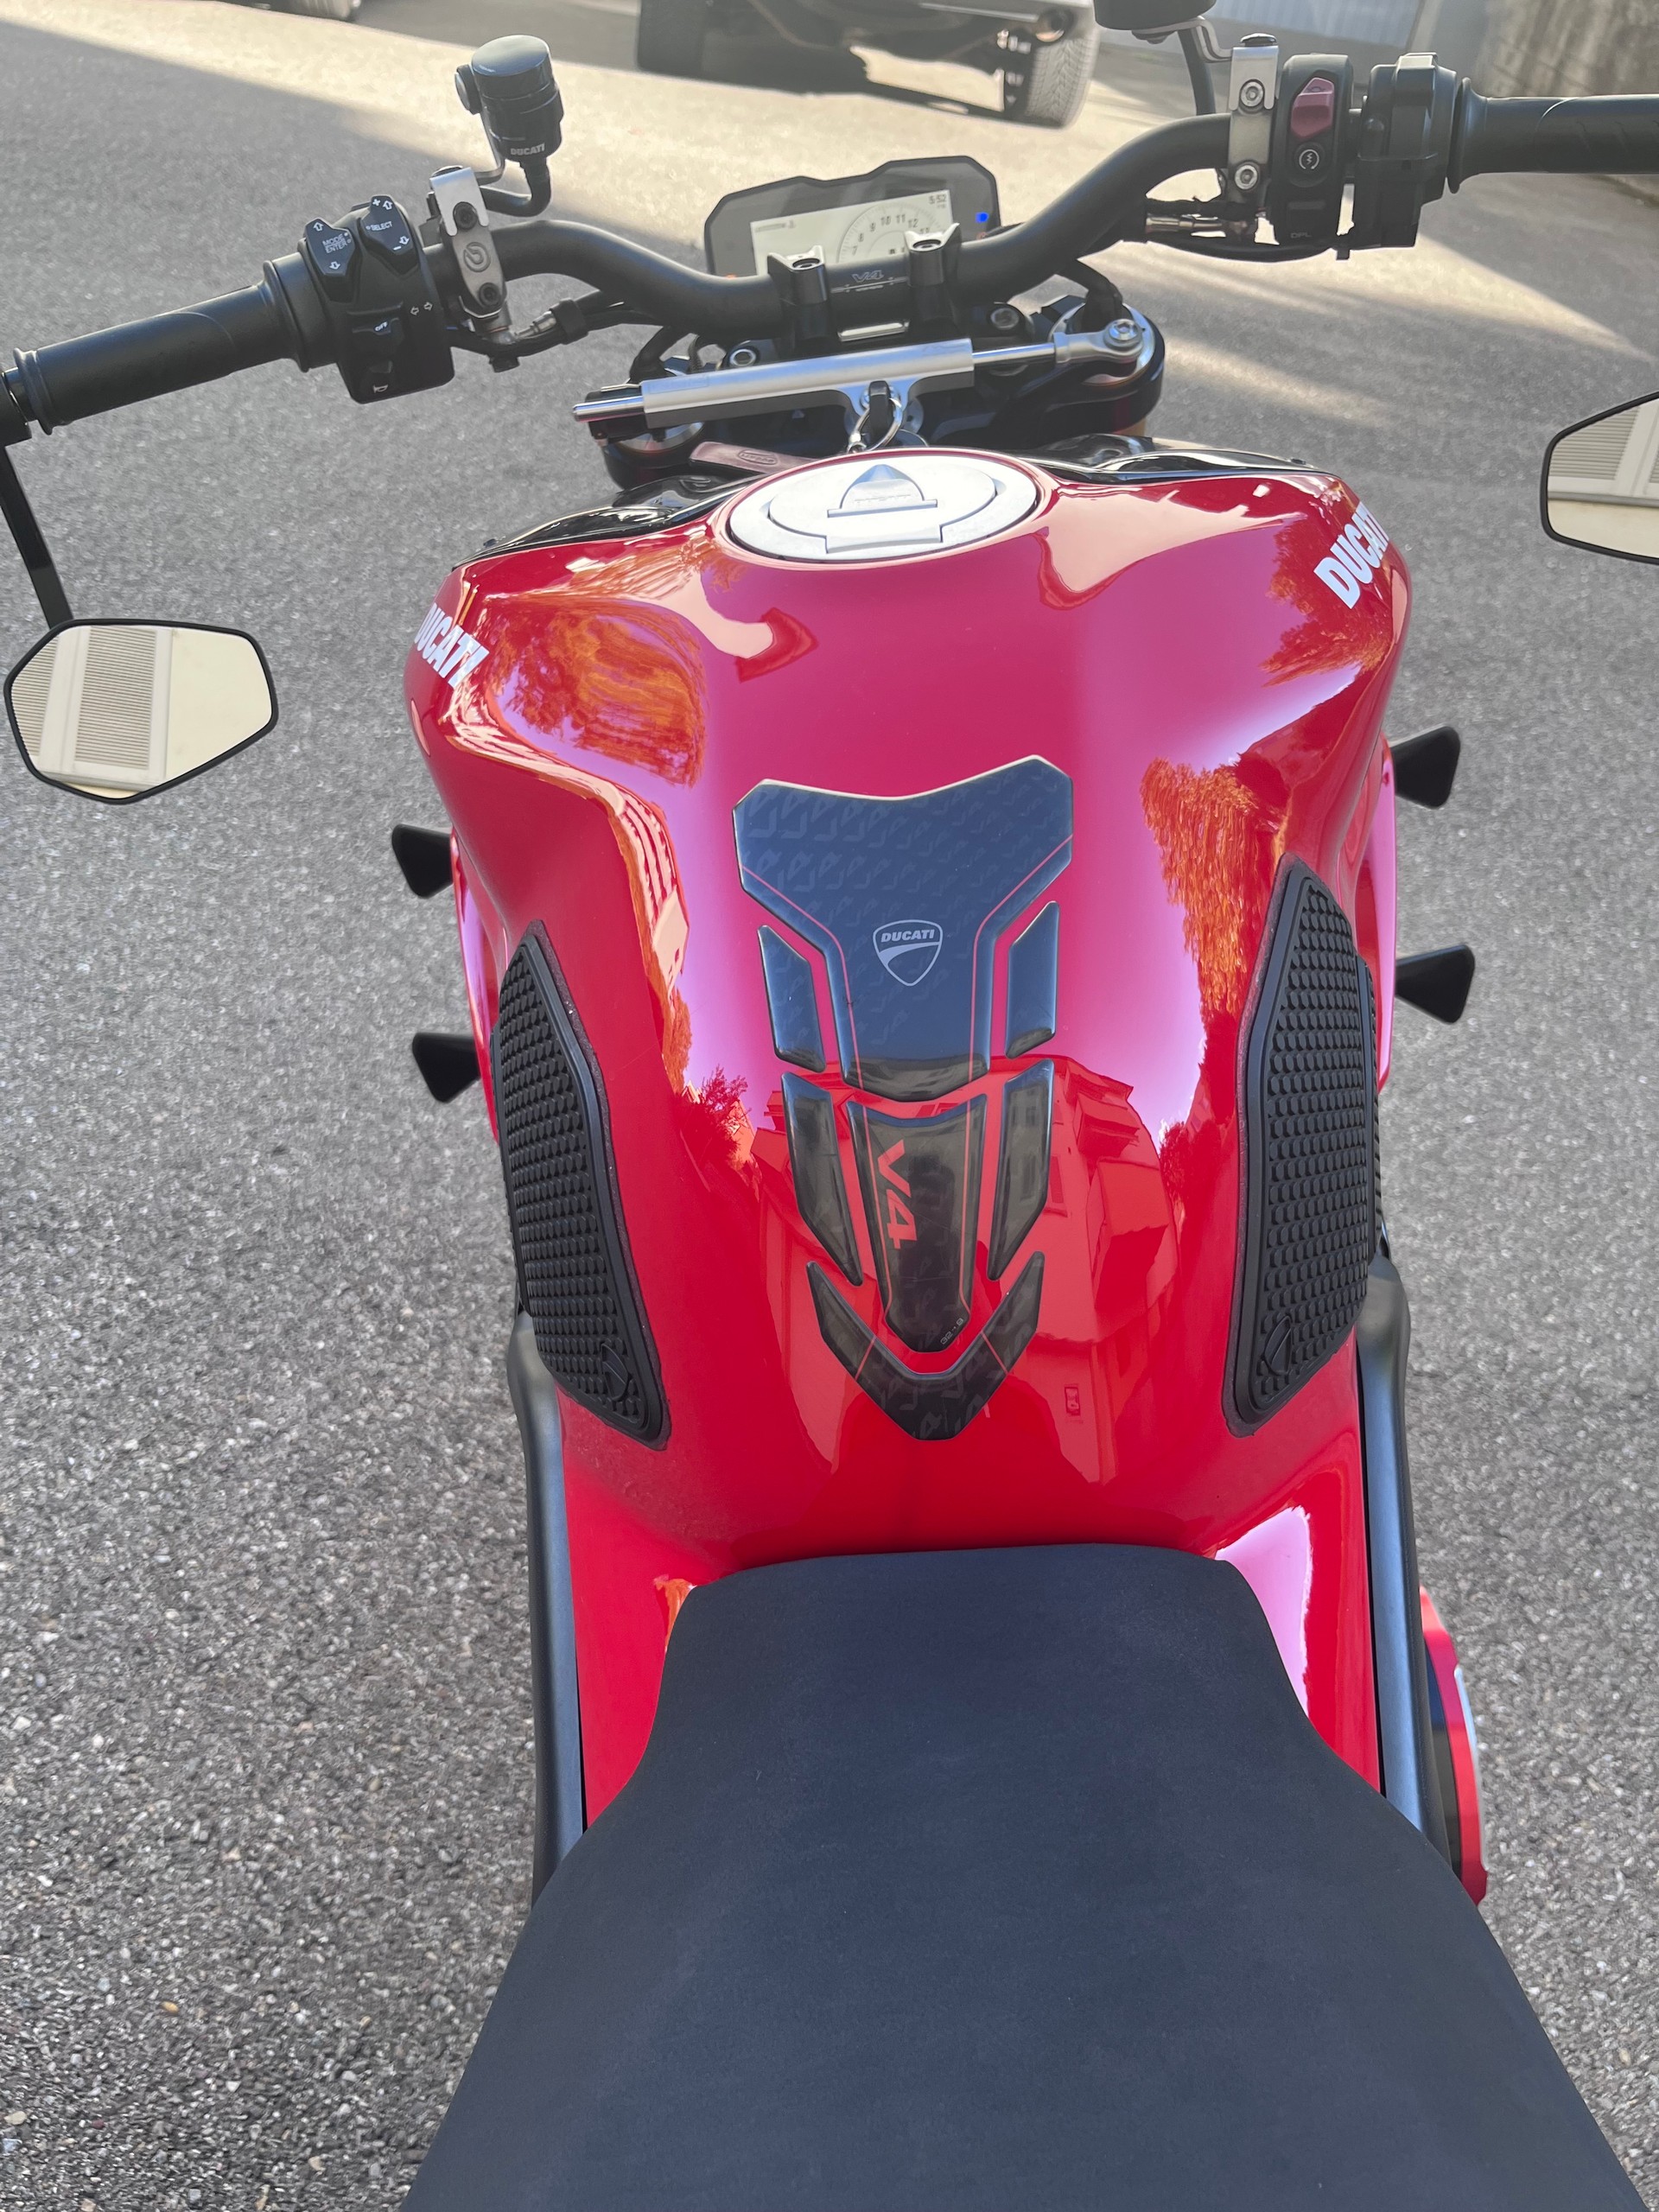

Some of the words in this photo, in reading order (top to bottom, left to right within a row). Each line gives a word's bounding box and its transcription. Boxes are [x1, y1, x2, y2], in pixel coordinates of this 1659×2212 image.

[510, 142, 546, 156] DUCATI
[370, 220, 393, 232] SELECT
[322, 233, 346, 245] MODE
[325, 241, 347, 254] ENTER
[880, 929, 935, 943] DUCATI
[877, 1139, 918, 1249] V4
